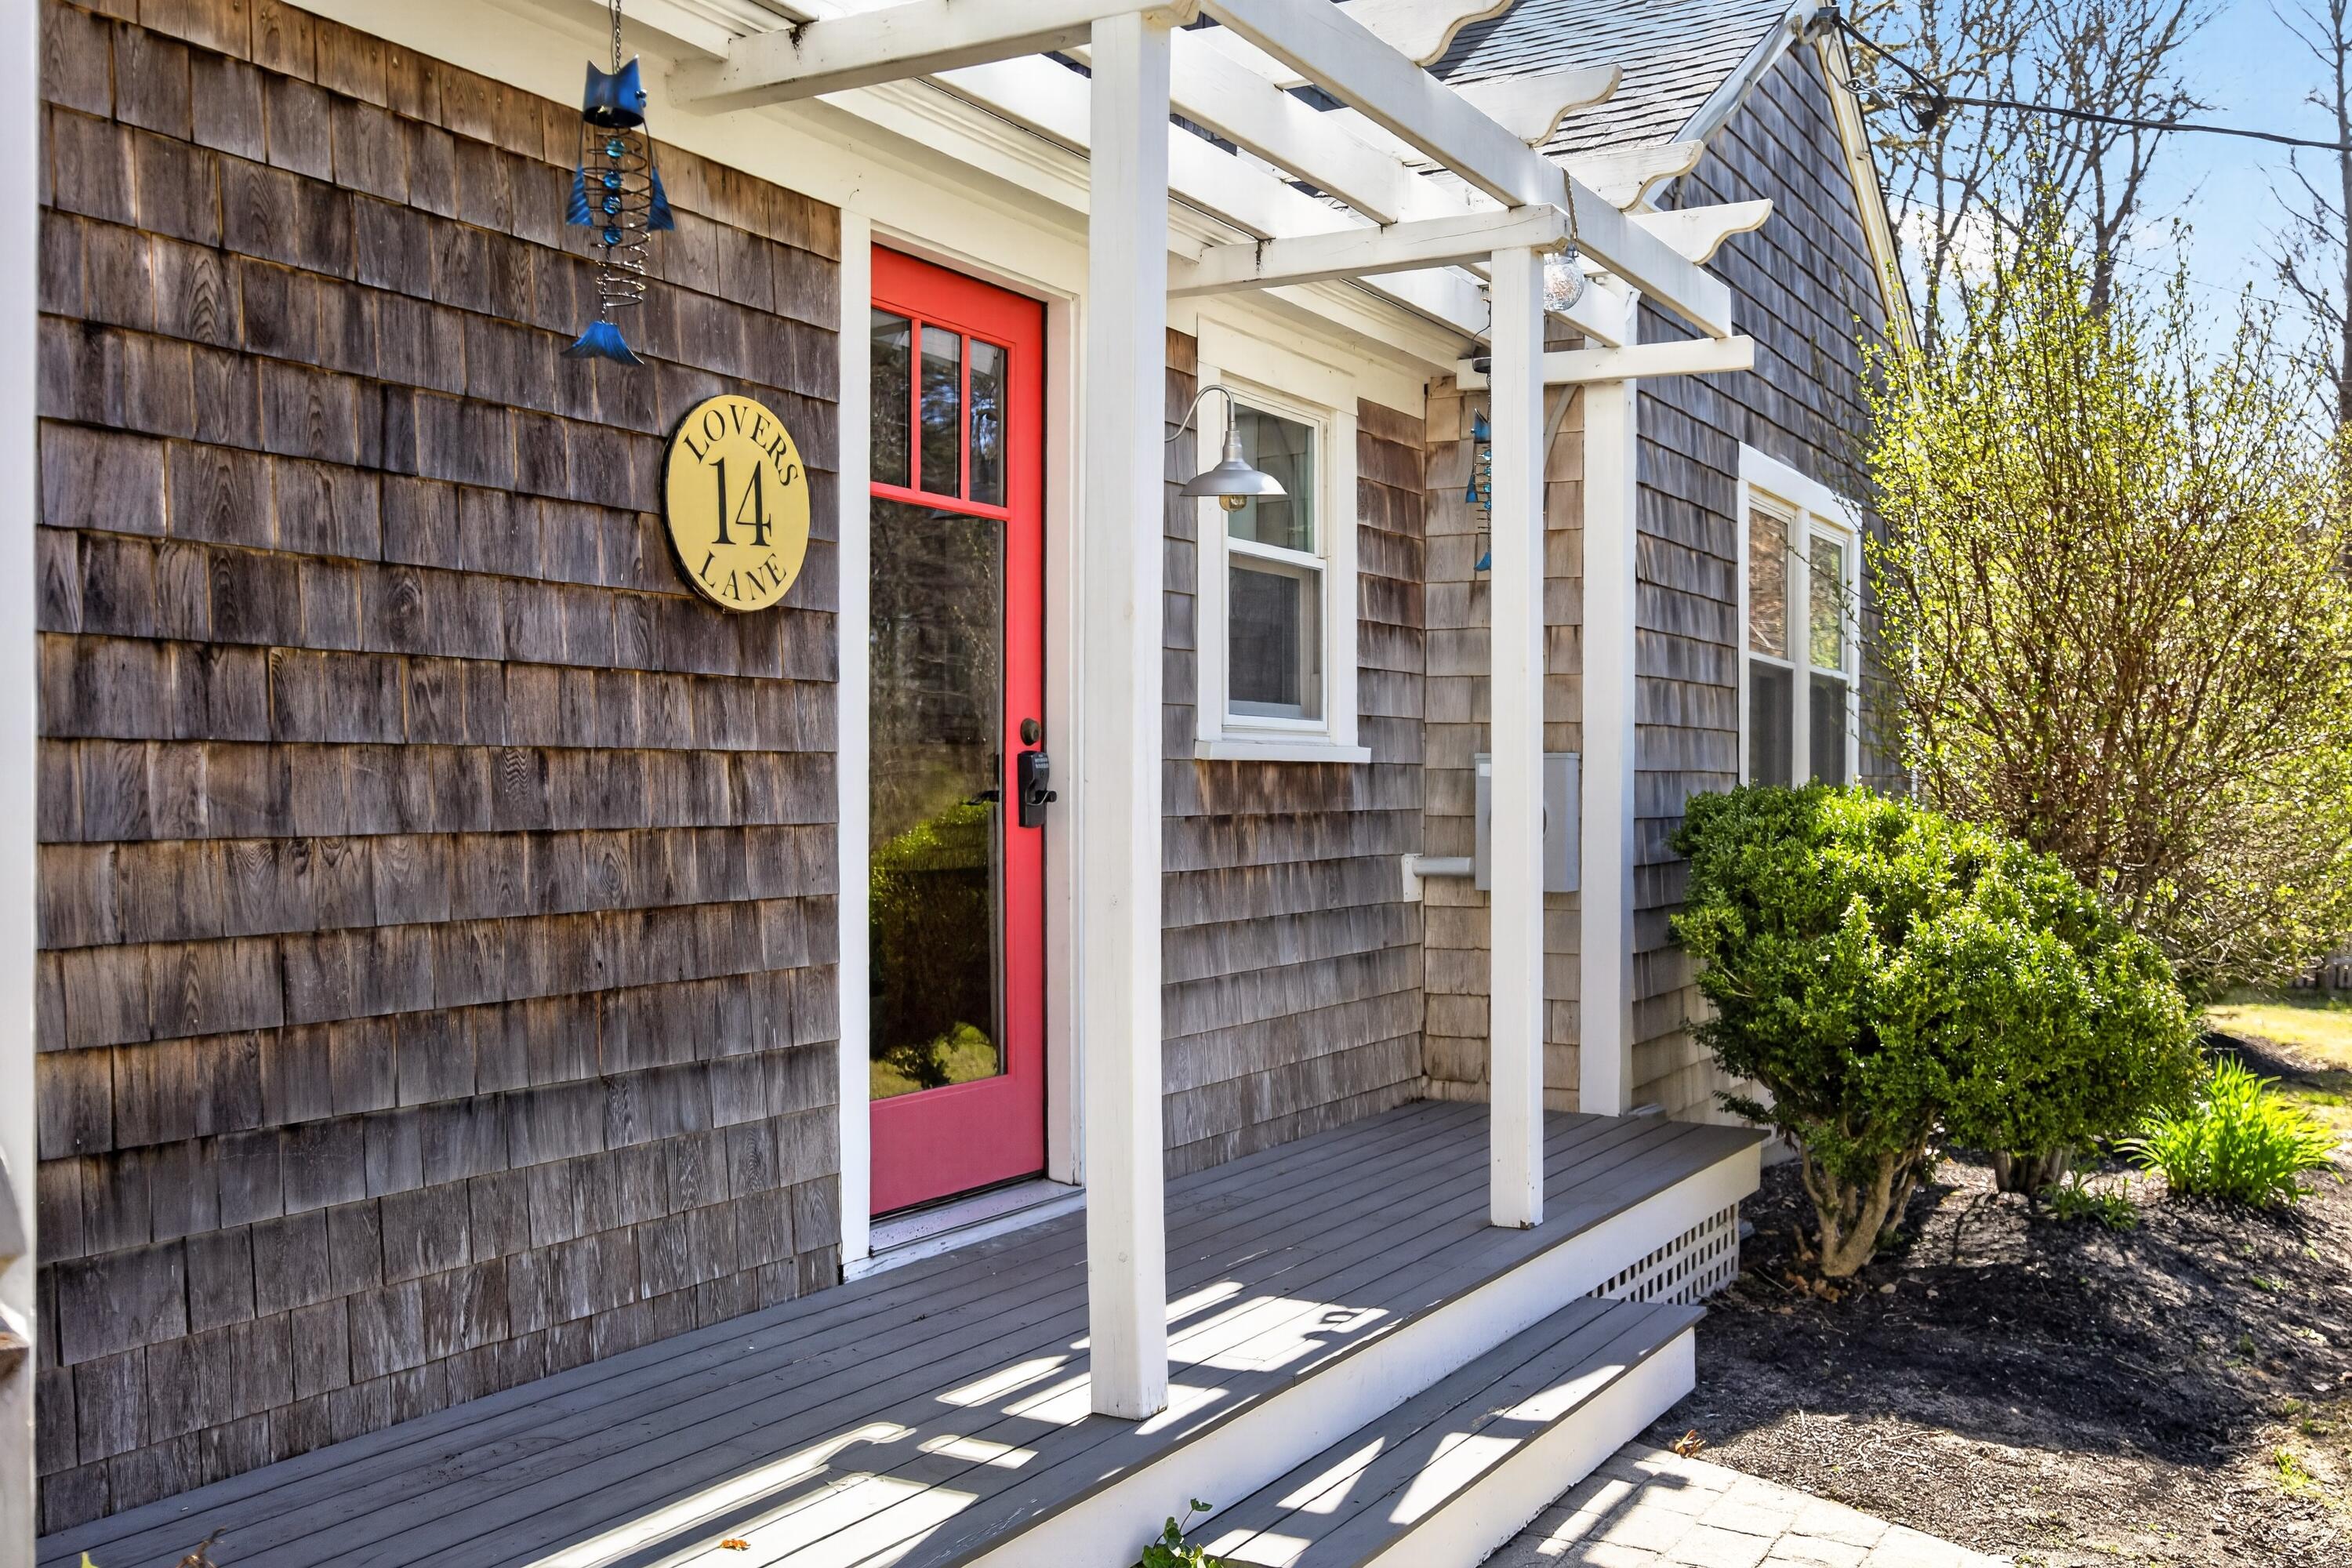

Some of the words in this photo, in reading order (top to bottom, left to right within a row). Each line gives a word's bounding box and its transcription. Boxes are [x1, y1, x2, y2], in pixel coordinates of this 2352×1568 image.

[682, 404, 799, 487] LOVERS
[709, 456, 772, 546] 14
[699, 550, 787, 601] LANE
